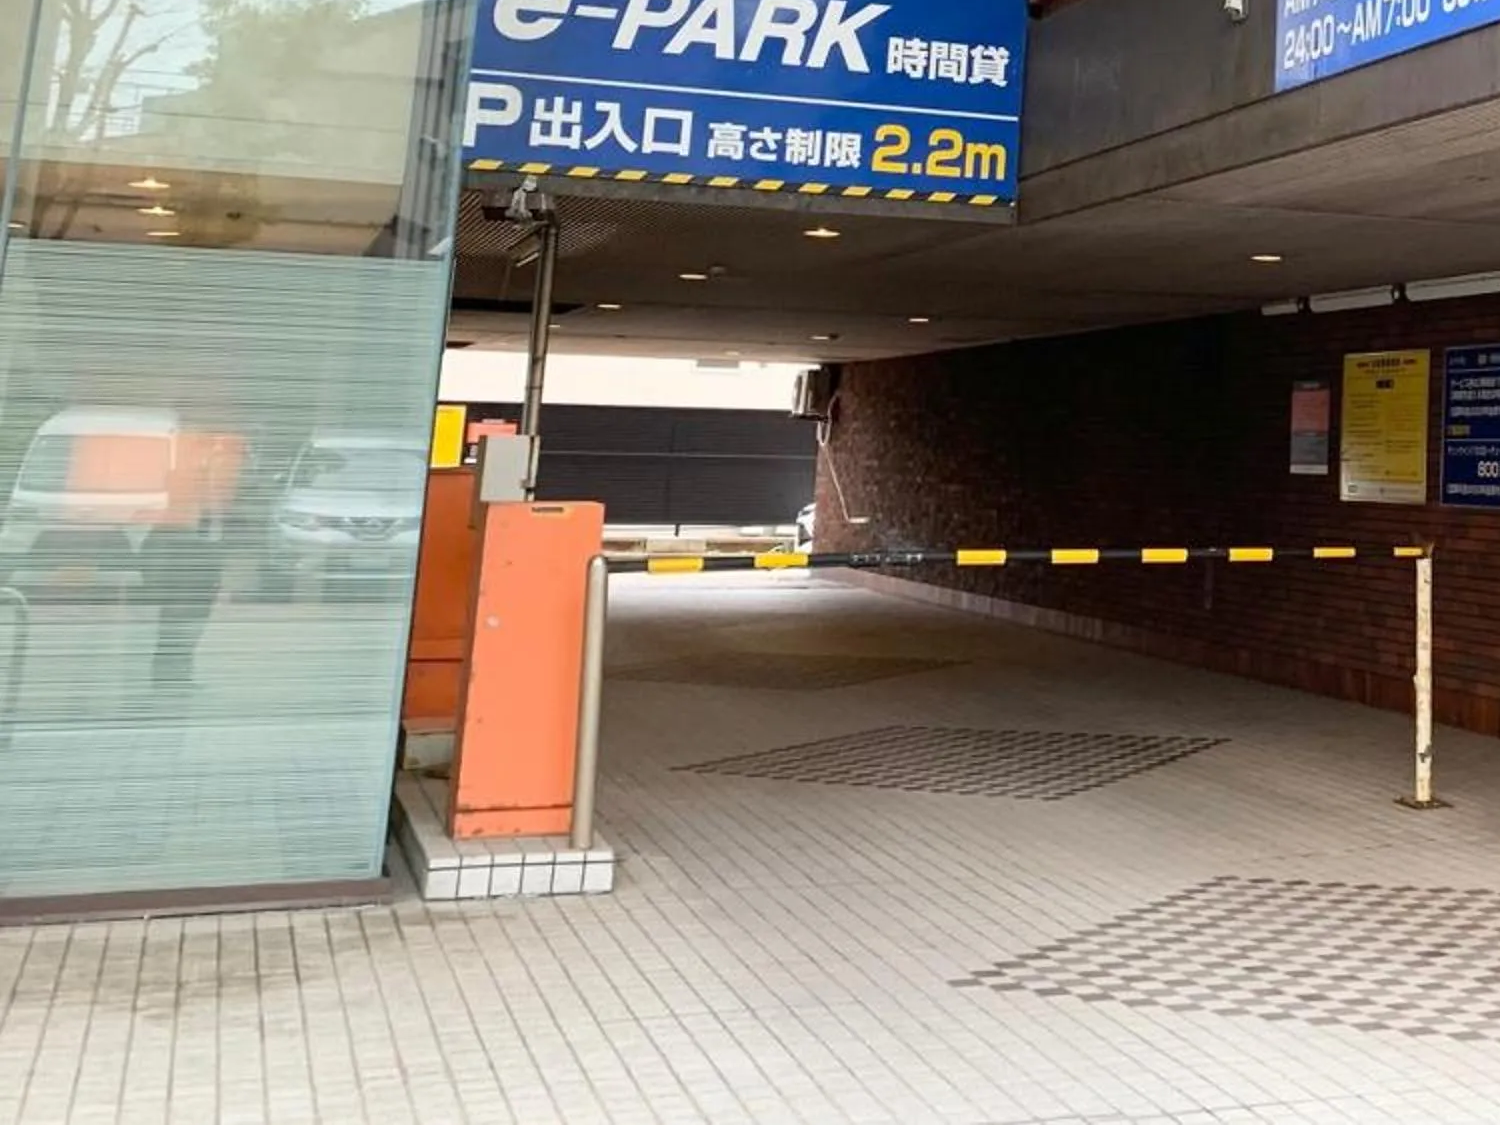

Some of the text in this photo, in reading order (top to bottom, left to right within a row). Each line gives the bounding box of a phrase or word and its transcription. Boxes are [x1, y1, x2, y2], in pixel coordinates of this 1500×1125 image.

[886, 36, 1010, 88] 時間貸
[463, 82, 1006, 181] P 出入口 高さ制限 2.2m
